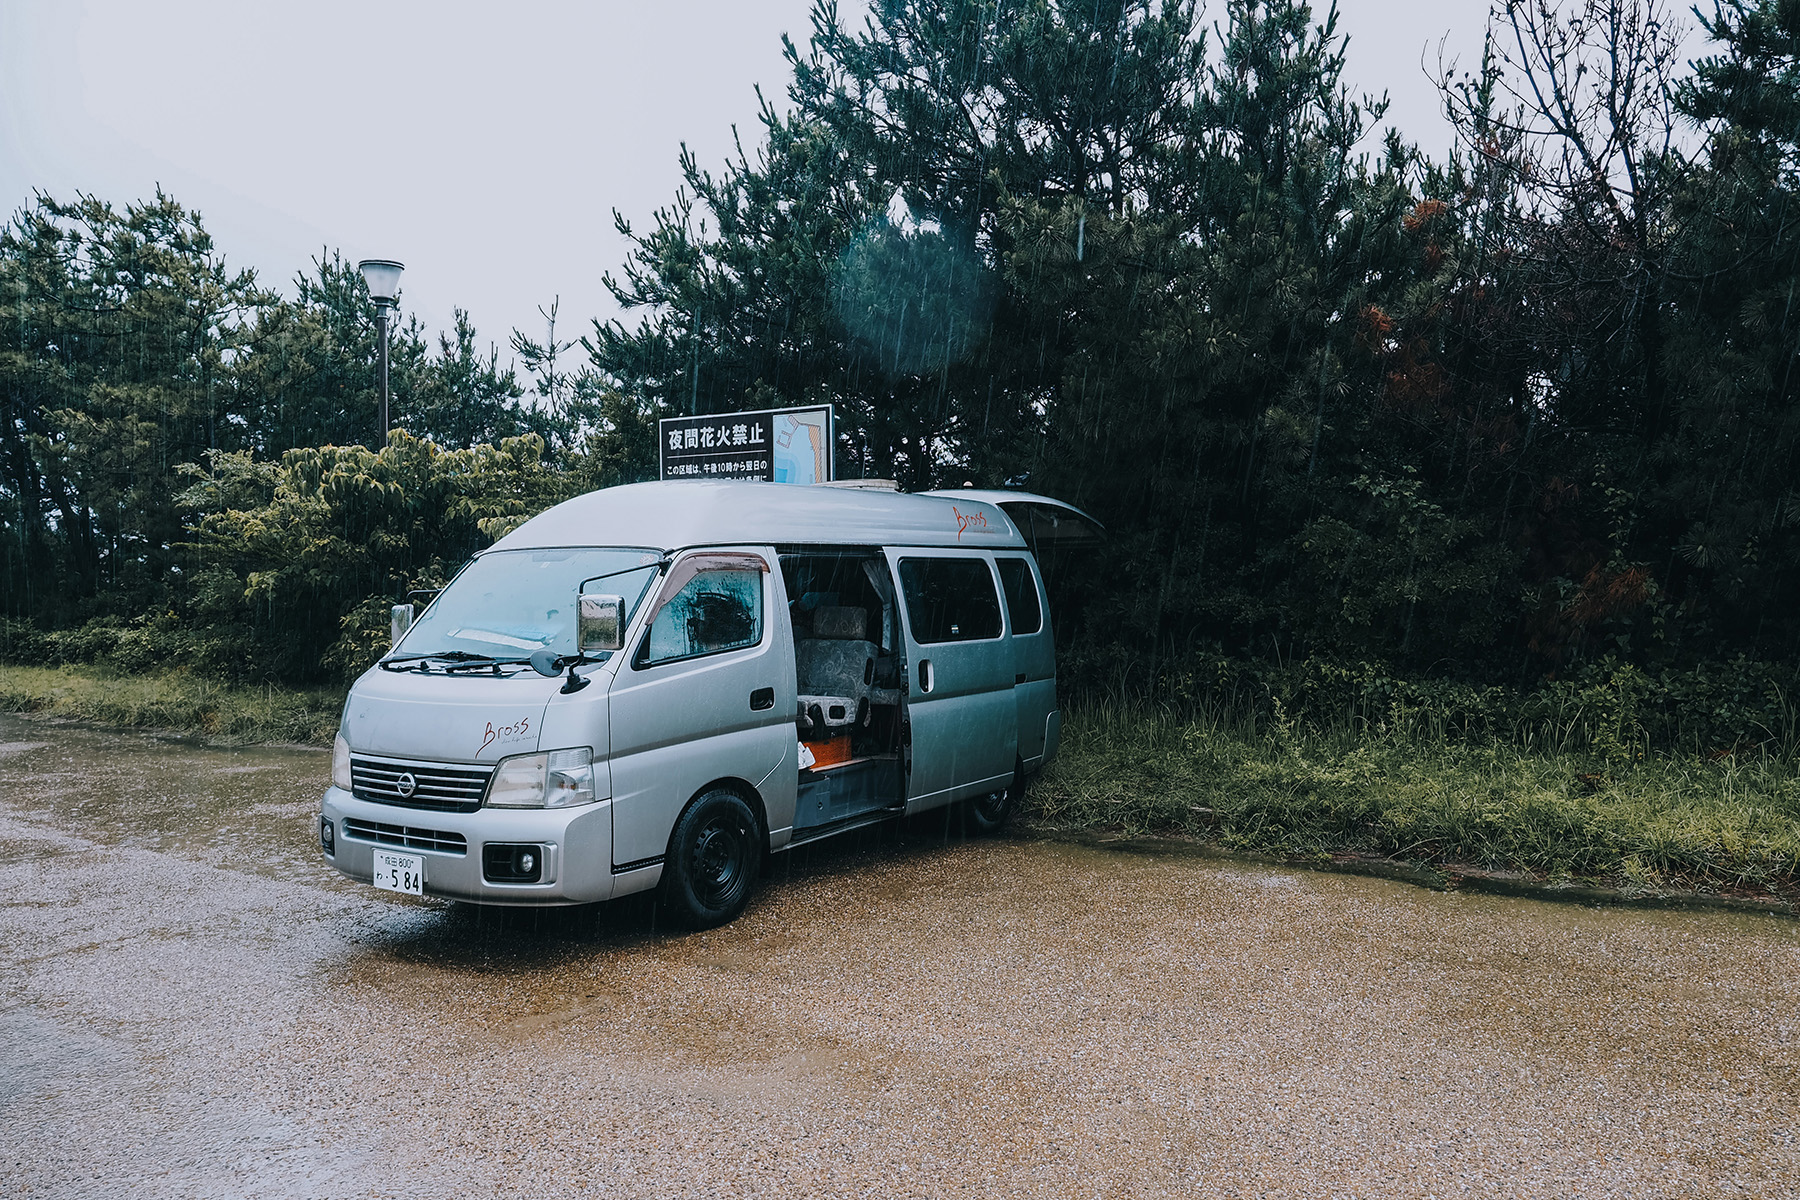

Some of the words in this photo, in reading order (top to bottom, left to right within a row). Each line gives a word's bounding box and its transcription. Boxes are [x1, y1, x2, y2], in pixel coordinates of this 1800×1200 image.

[668, 422, 765, 450] 夜間花火禁止
[667, 460, 767, 475] この区域は、午後10時から翌日の
[952, 506, 987, 542] Bross
[475, 717, 529, 759] Bross
